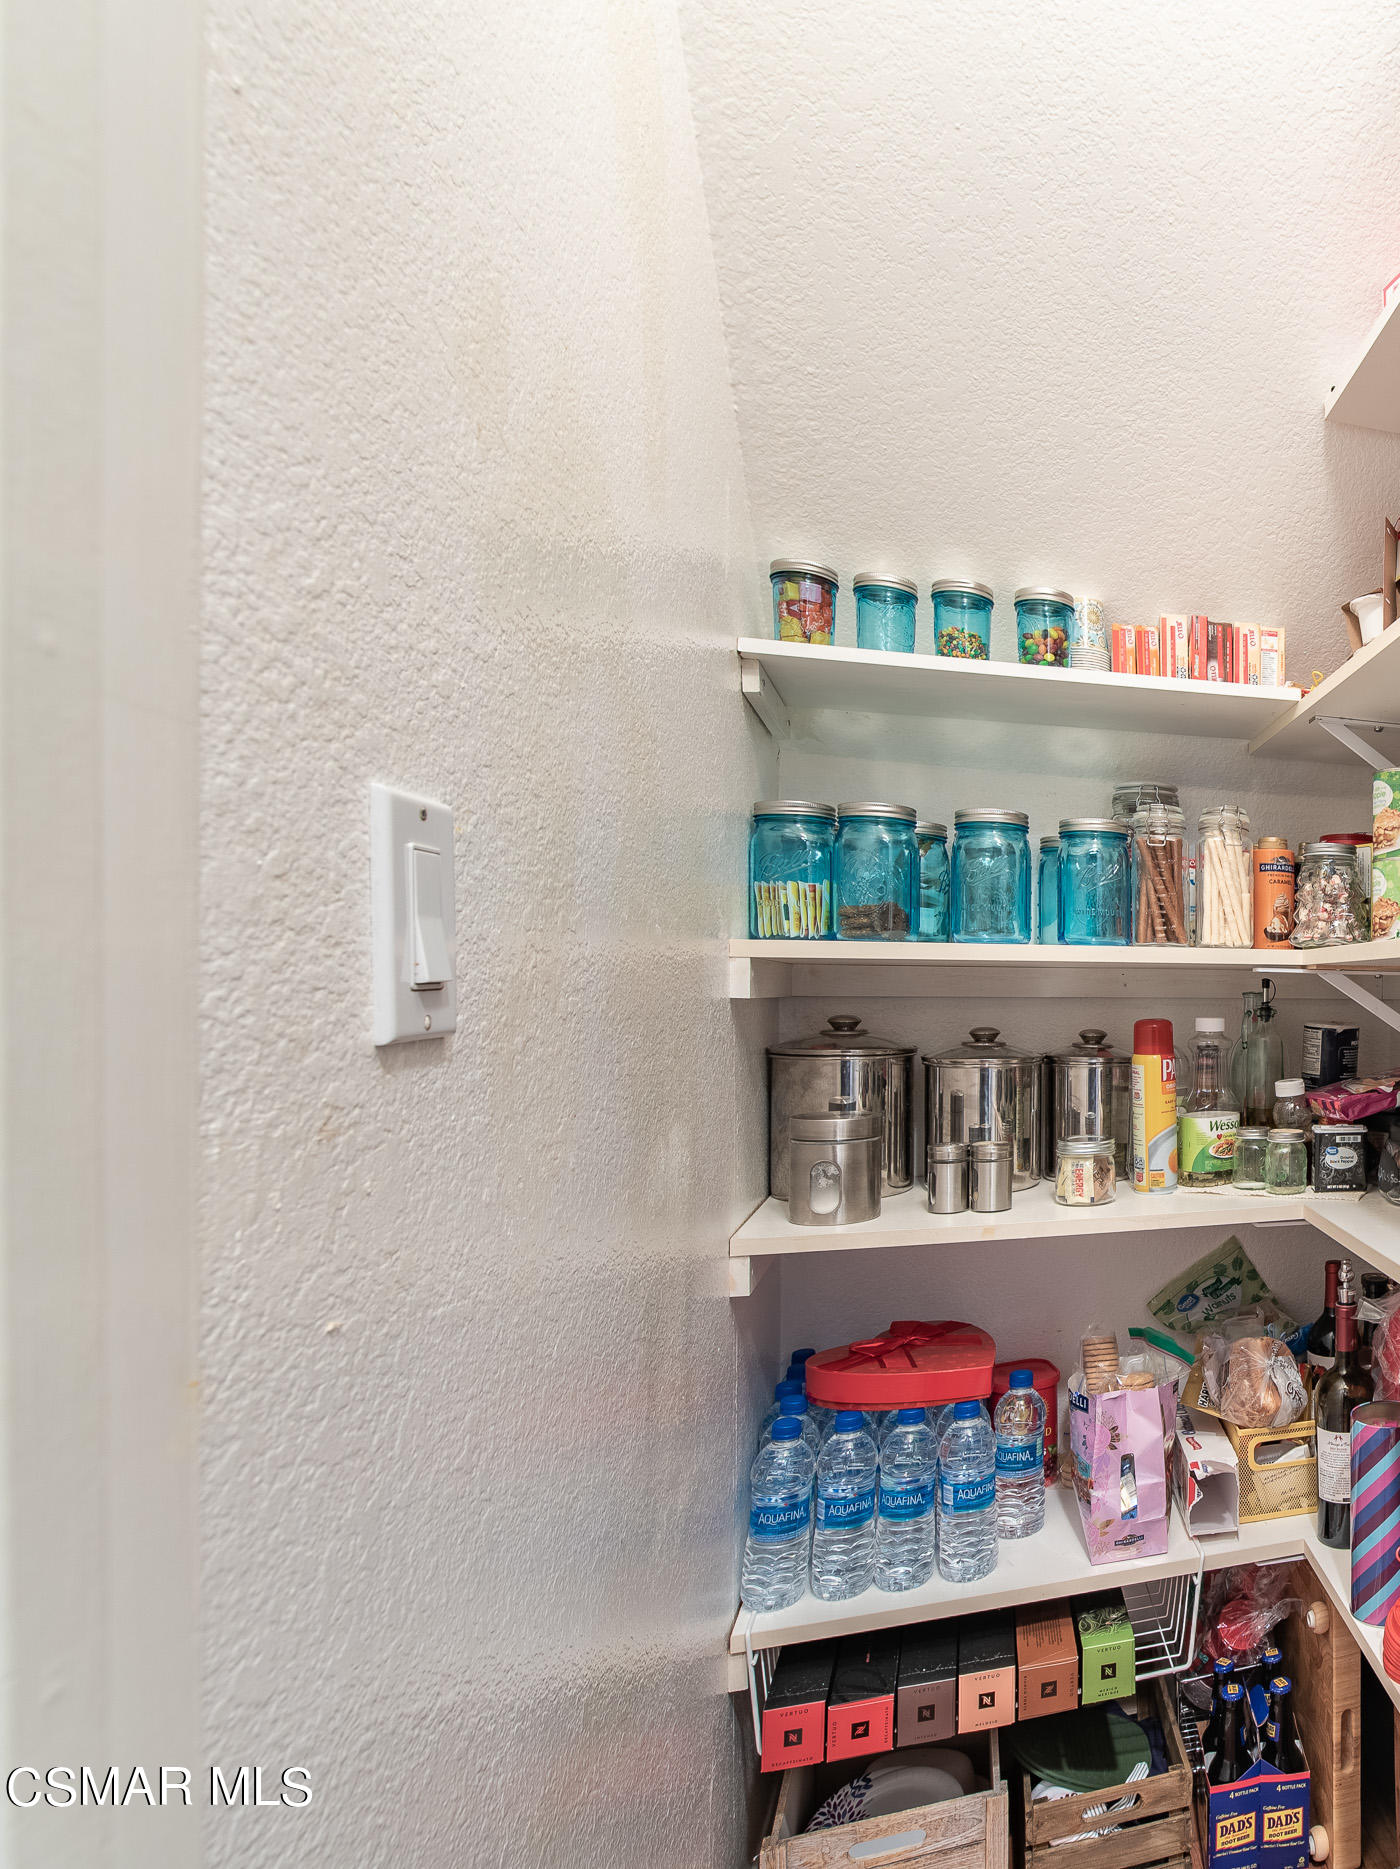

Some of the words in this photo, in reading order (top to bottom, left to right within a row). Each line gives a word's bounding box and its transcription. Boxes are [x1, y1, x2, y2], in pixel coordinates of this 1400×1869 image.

[1268, 878, 1293, 886] CARAMEL
[1162, 1058, 1176, 1082] PA
[1075, 1168, 1084, 1198] ENERGY
[1201, 1291, 1237, 1316] Walnuts
[828, 1497, 873, 1517] AQUAFINA
[881, 1493, 924, 1509] AQUAFINA
[758, 1508, 806, 1525] AQUAFINA
[1096, 1645, 1121, 1653] VERTUO
[974, 1672, 1001, 1681] VERTUO
[913, 1685, 940, 1694] VERTUO
[779, 1708, 809, 1718] VERTUO
[1229, 1791, 1234, 1799] 4
[1276, 1784, 1281, 1792] 4
[1219, 1816, 1253, 1838] DAD'S
[1267, 1811, 1300, 1830] DAD'S
[1221, 1838, 1236, 1847] ROOT
[1236, 1833, 1250, 1841] BEER
